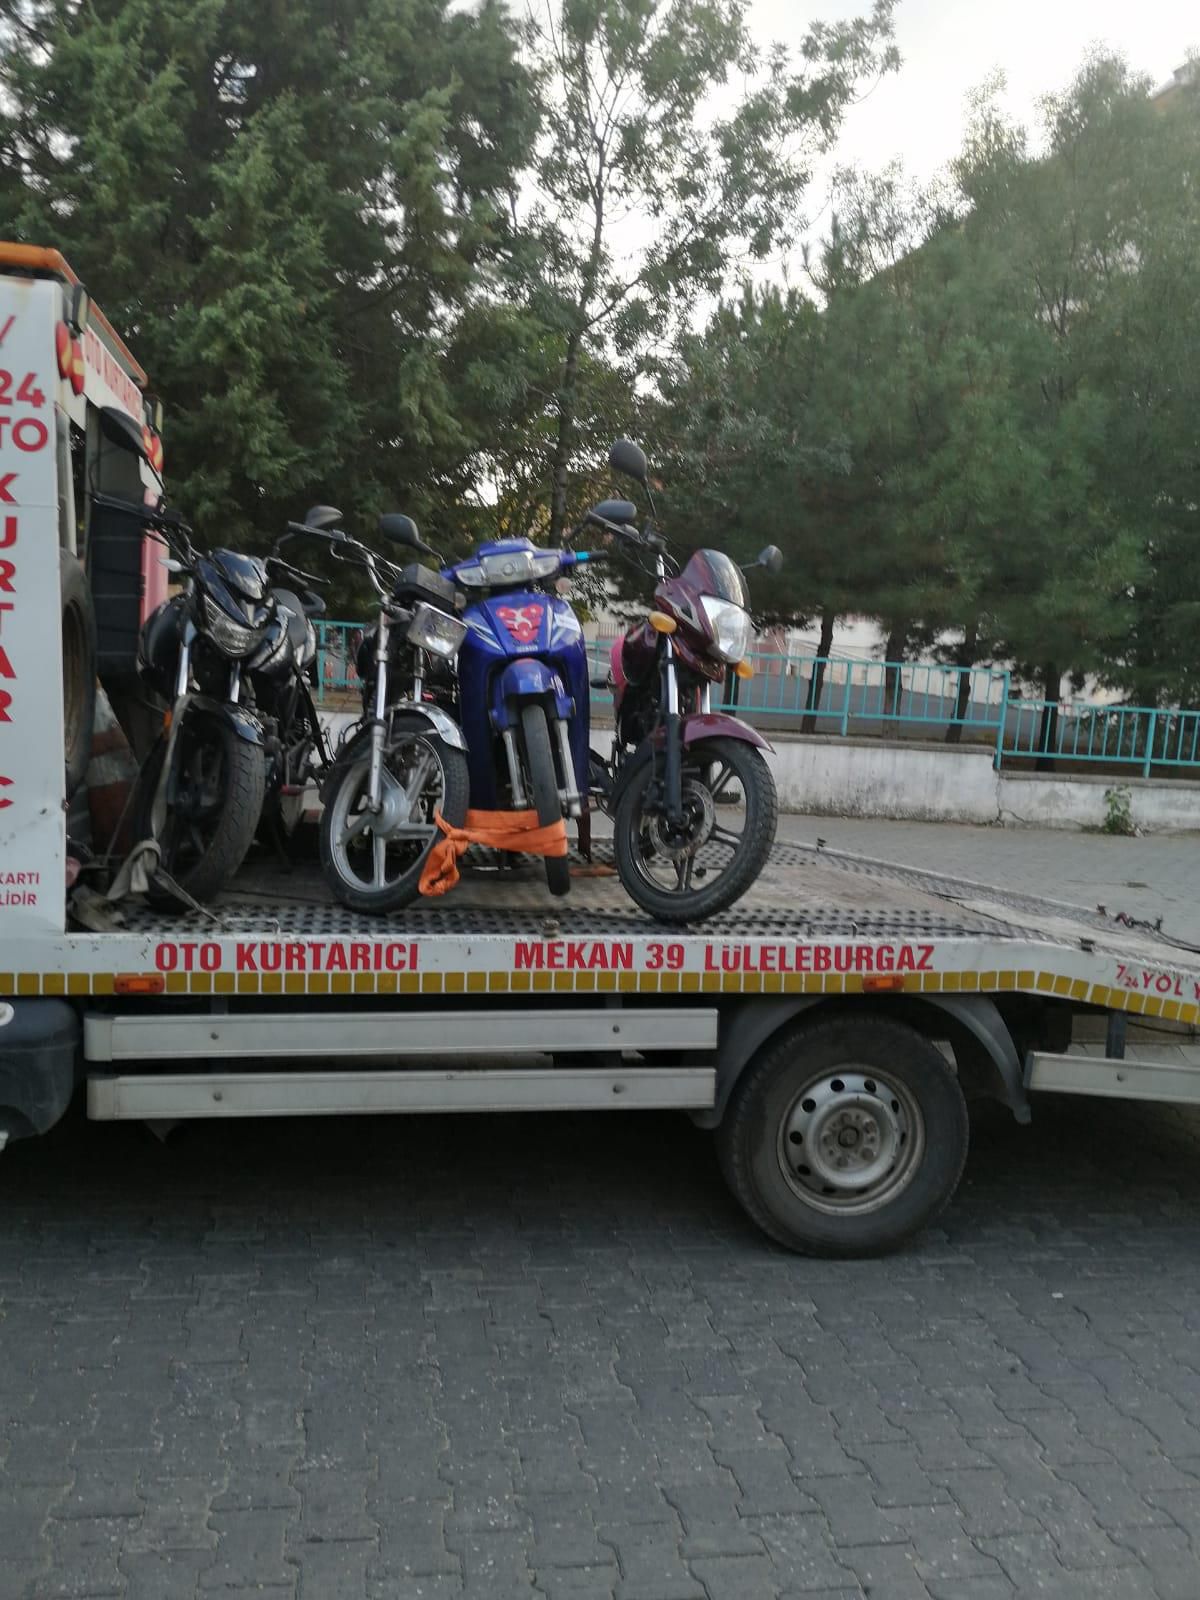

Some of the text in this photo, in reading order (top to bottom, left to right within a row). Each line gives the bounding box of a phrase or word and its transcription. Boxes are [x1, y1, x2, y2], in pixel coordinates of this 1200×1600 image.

[155, 942, 935, 972] OTO KURTARICI MEKAN 39 LÜLELEBURGAZ
[1142, 971, 1183, 996] YOL
